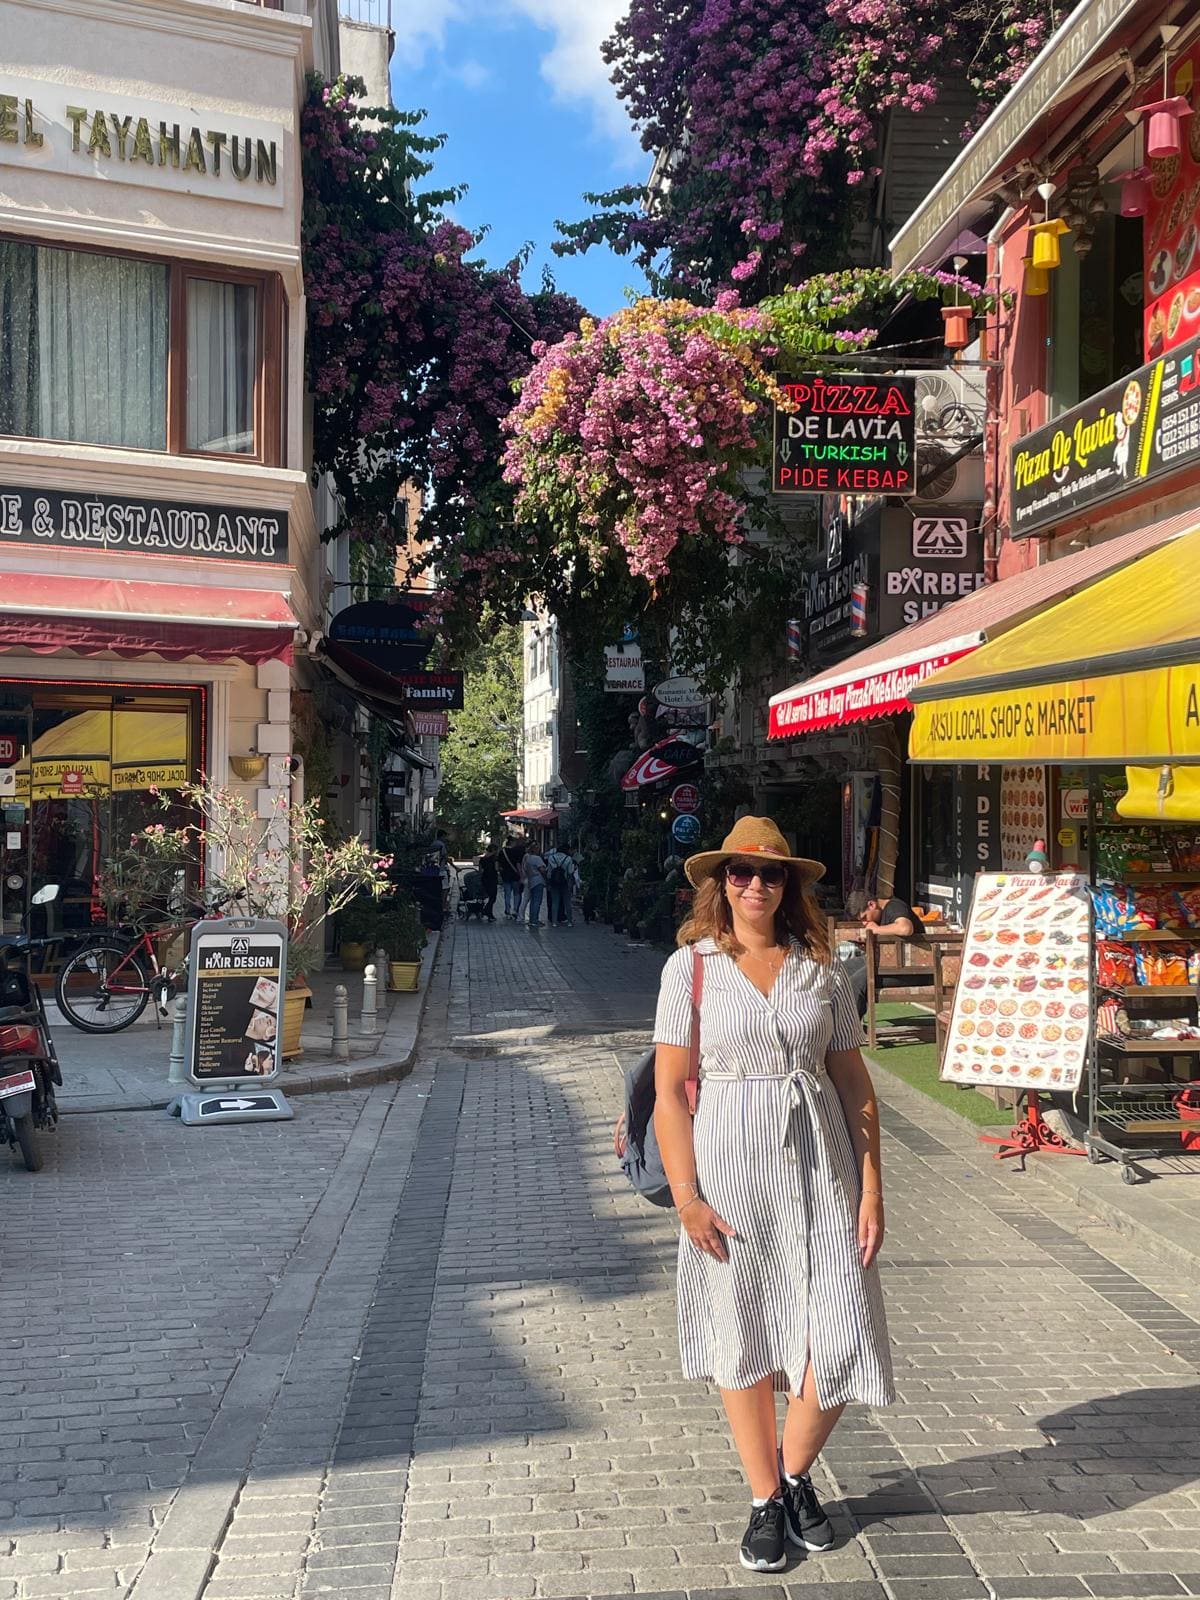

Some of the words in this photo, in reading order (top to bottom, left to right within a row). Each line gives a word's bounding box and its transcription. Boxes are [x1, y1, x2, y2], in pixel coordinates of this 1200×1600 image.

[66, 105, 277, 185] TAYAHATUN
[788, 416, 820, 438] DE
[801, 445, 887, 461] TURKISH
[1015, 451, 1050, 490] Pizza
[1052, 430, 1072, 471] De
[1074, 408, 1117, 468] Lavia
[780, 464, 828, 487] PİDE
[838, 469, 909, 488] KEBAP
[1, 495, 21, 536] E
[32, 498, 54, 538] &
[61, 500, 278, 556] RESTAURANT
[829, 553, 868, 605] DESIGN
[406, 686, 455, 700] Family
[814, 691, 828, 718] Take
[928, 713, 952, 742] AKSU
[955, 706, 987, 741] LOCAL
[991, 702, 1021, 737] SHOP
[1025, 706, 1034, 736] &
[1038, 695, 1095, 735] MARKET
[233, 957, 273, 968] DESIGN
